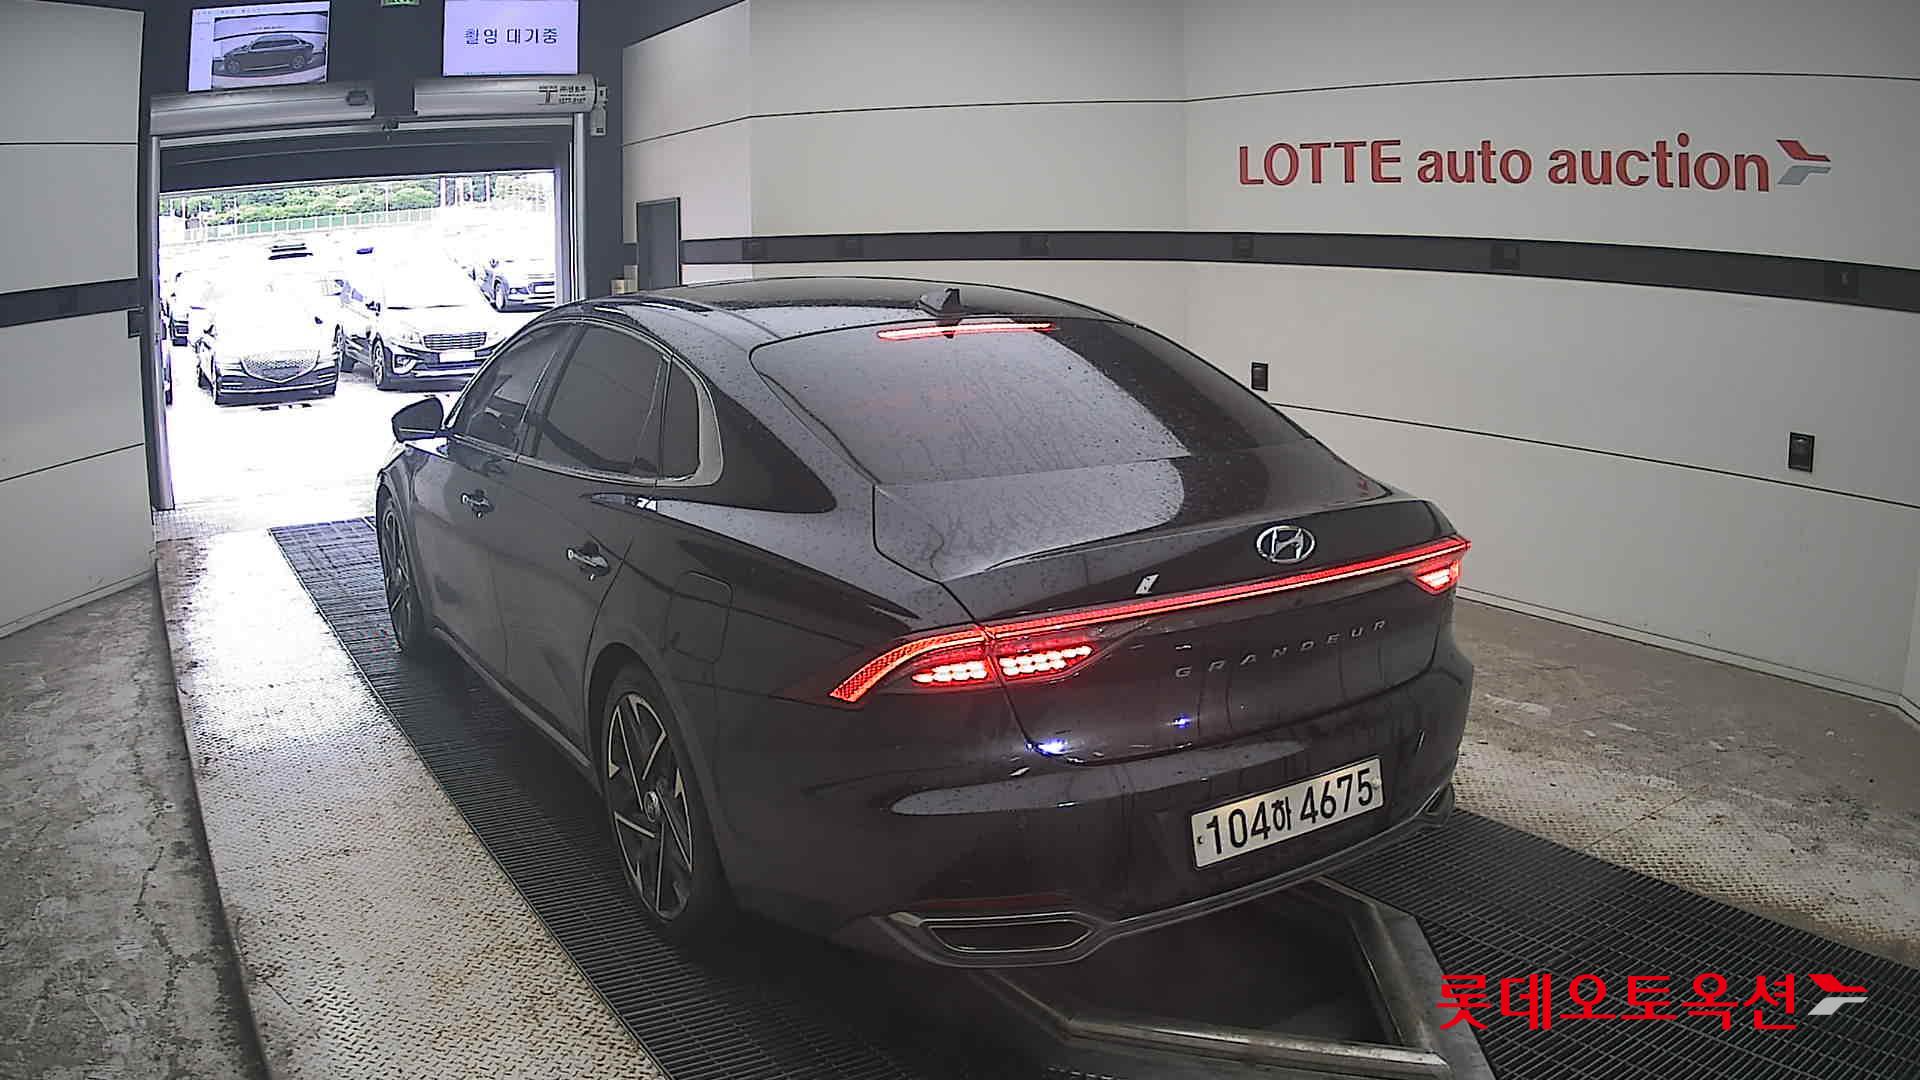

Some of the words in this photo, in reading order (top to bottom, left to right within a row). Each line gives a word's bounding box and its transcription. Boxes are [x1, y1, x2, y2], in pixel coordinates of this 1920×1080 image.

[506, 27, 558, 45] 대기중
[1239, 139, 1402, 186] LOTTE
[1416, 140, 1533, 184] auto
[1548, 132, 1769, 192] auction
[1175, 619, 1386, 678] GRANDEUR
